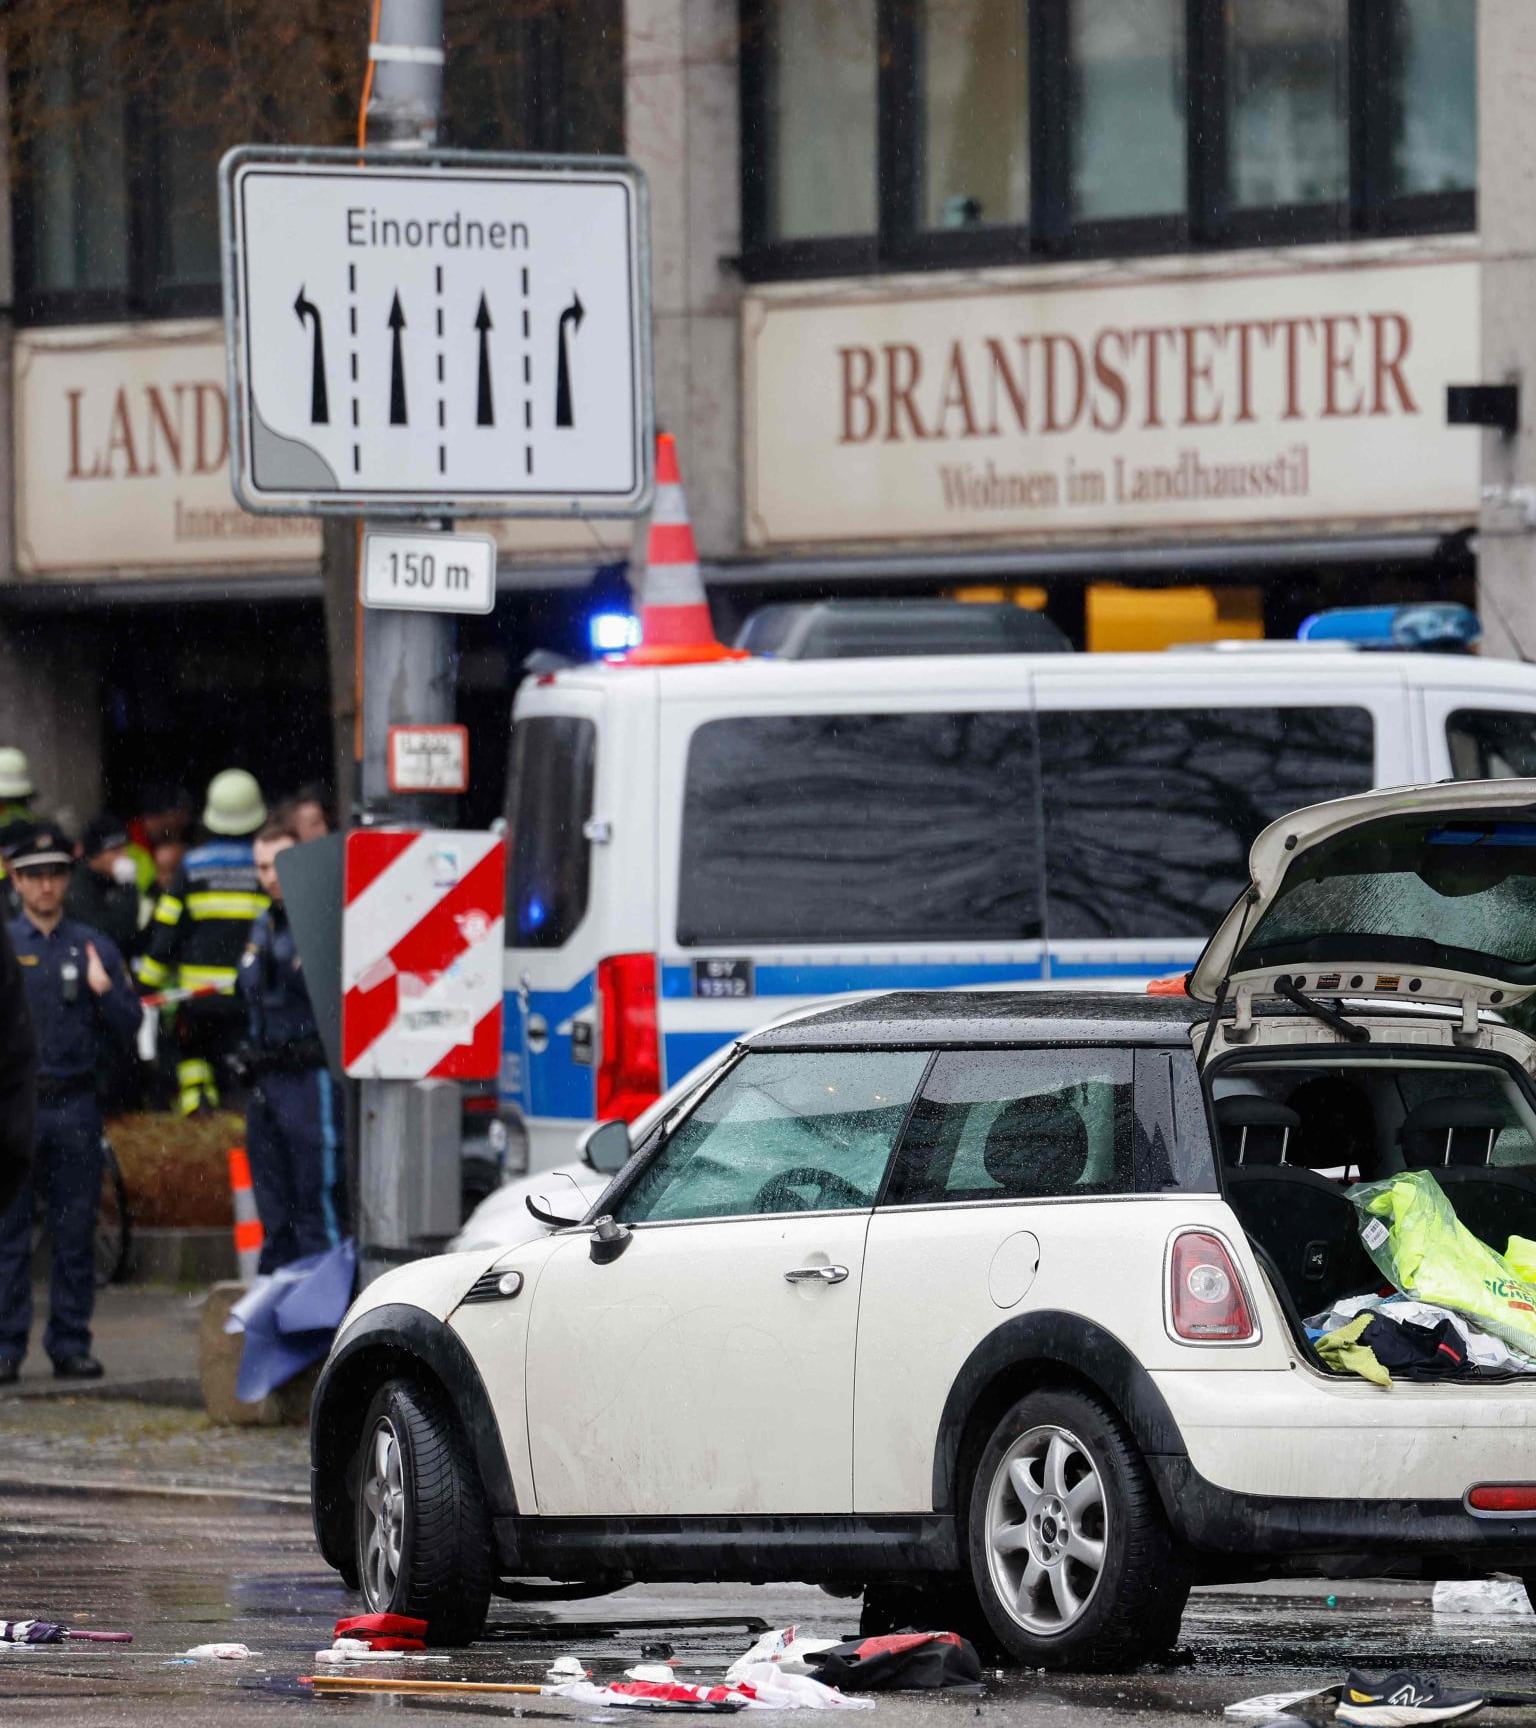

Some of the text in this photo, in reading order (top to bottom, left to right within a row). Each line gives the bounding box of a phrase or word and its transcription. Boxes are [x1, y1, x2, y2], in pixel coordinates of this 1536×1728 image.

[347, 208, 529, 249] Einordnen
[836, 309, 1420, 446] BRANDSTETTER
[65, 380, 245, 480] LAND
[939, 443, 1310, 511] Wohnen im Landhausstil
[389, 553, 469, 589] 150 m
[707, 960, 736, 977] BY
